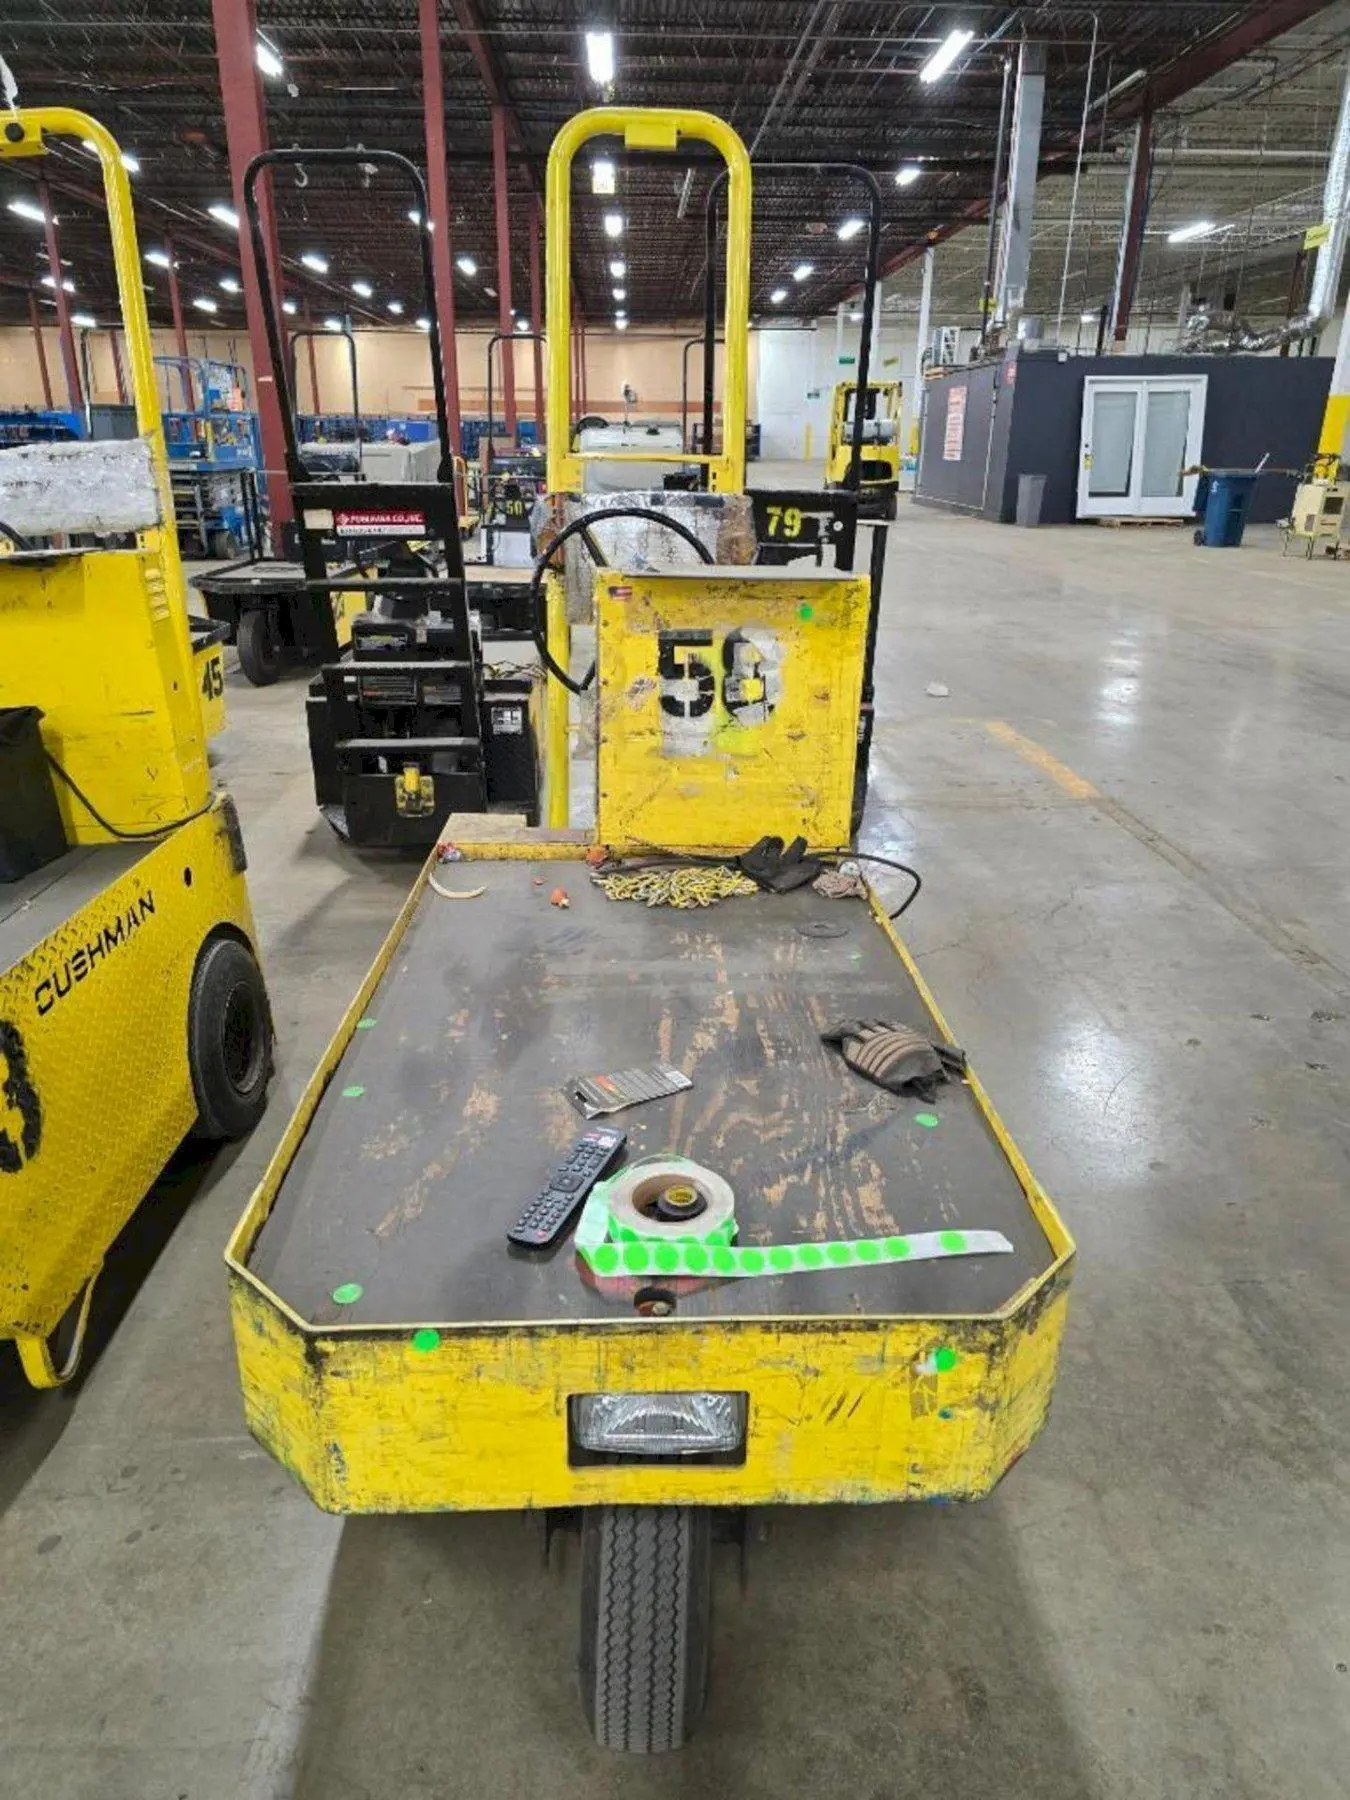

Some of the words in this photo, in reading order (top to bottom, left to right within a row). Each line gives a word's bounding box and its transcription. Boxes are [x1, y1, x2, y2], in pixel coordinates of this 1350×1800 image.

[506, 500, 523, 516] 50
[766, 506, 802, 538] 79
[202, 656, 224, 701] 45
[33, 889, 157, 1017] CUSHMAN
